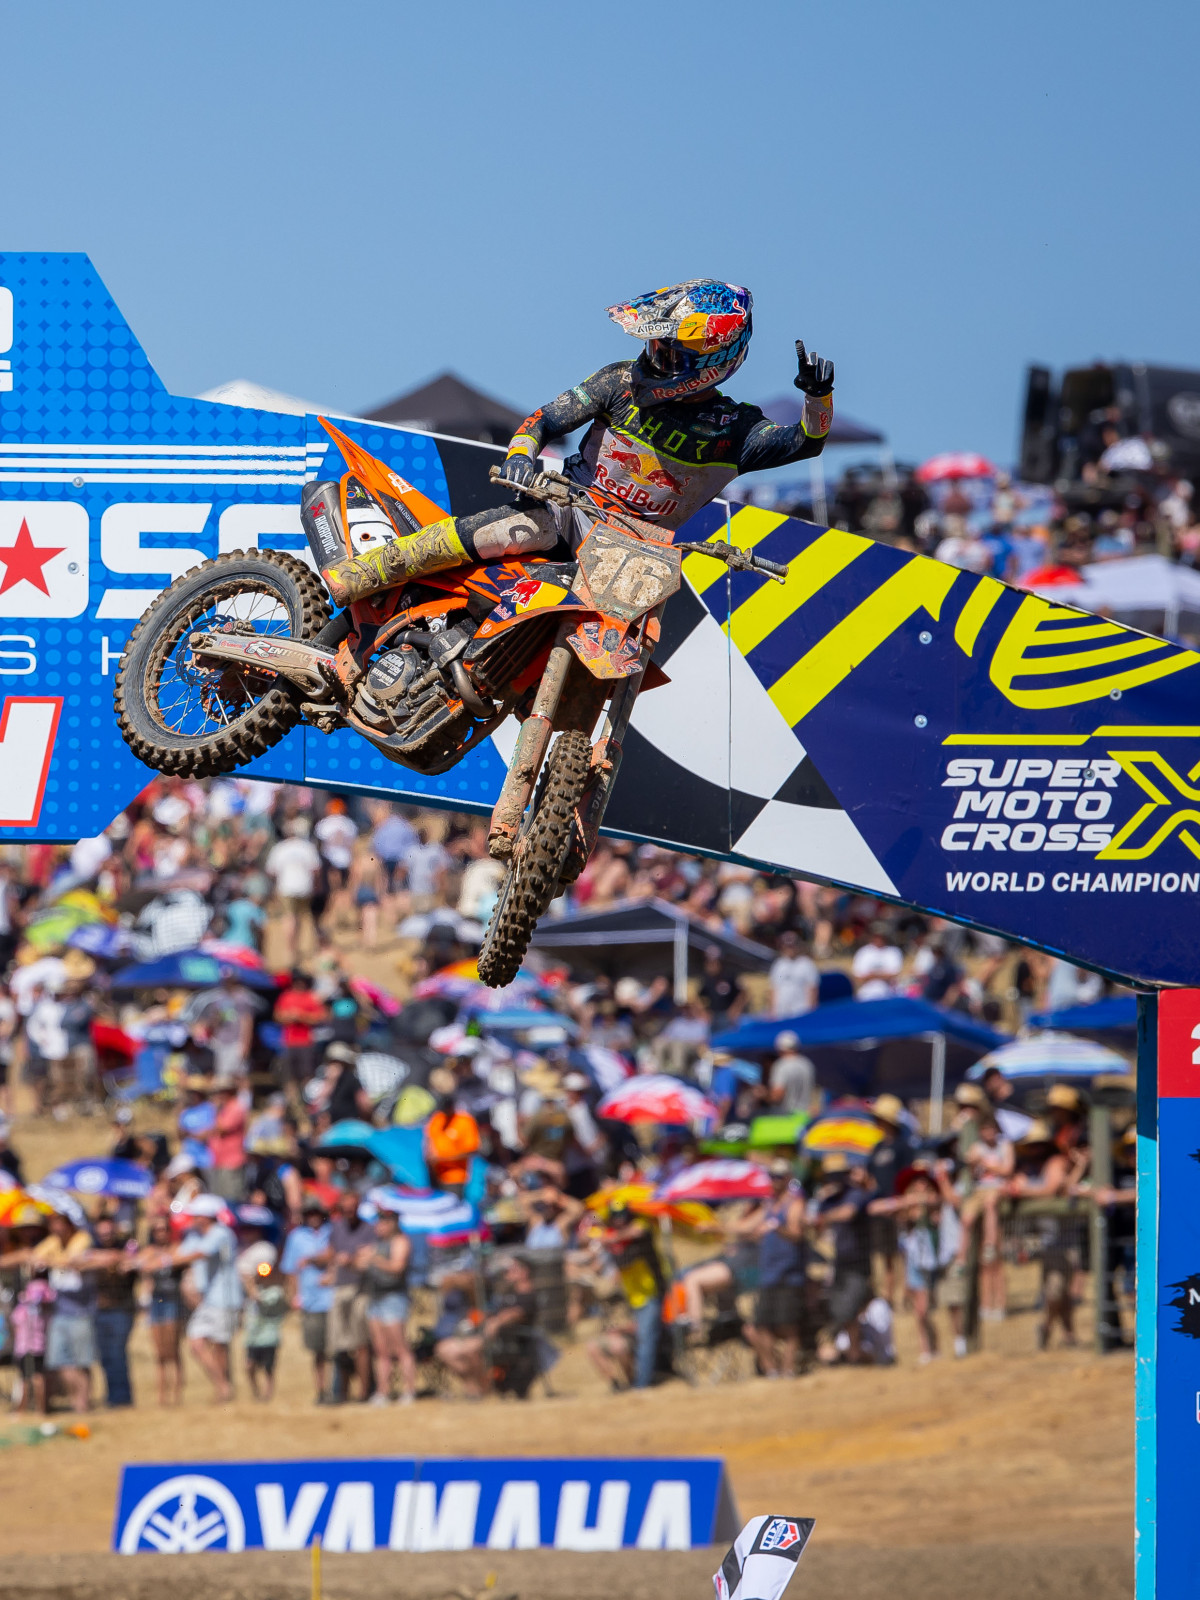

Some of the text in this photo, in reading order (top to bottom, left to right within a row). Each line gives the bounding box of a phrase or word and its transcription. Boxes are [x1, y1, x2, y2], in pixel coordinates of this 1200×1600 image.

[637, 323, 670, 334] AIROH
[624, 404, 709, 460] THOR
[589, 547, 672, 608] 16
[941, 758, 1122, 788] SUPER
[952, 790, 1113, 821] MOTO
[940, 823, 1115, 852] CROSS
[946, 872, 1045, 893] WORLD
[255, 1480, 691, 1553] YAMAHA
